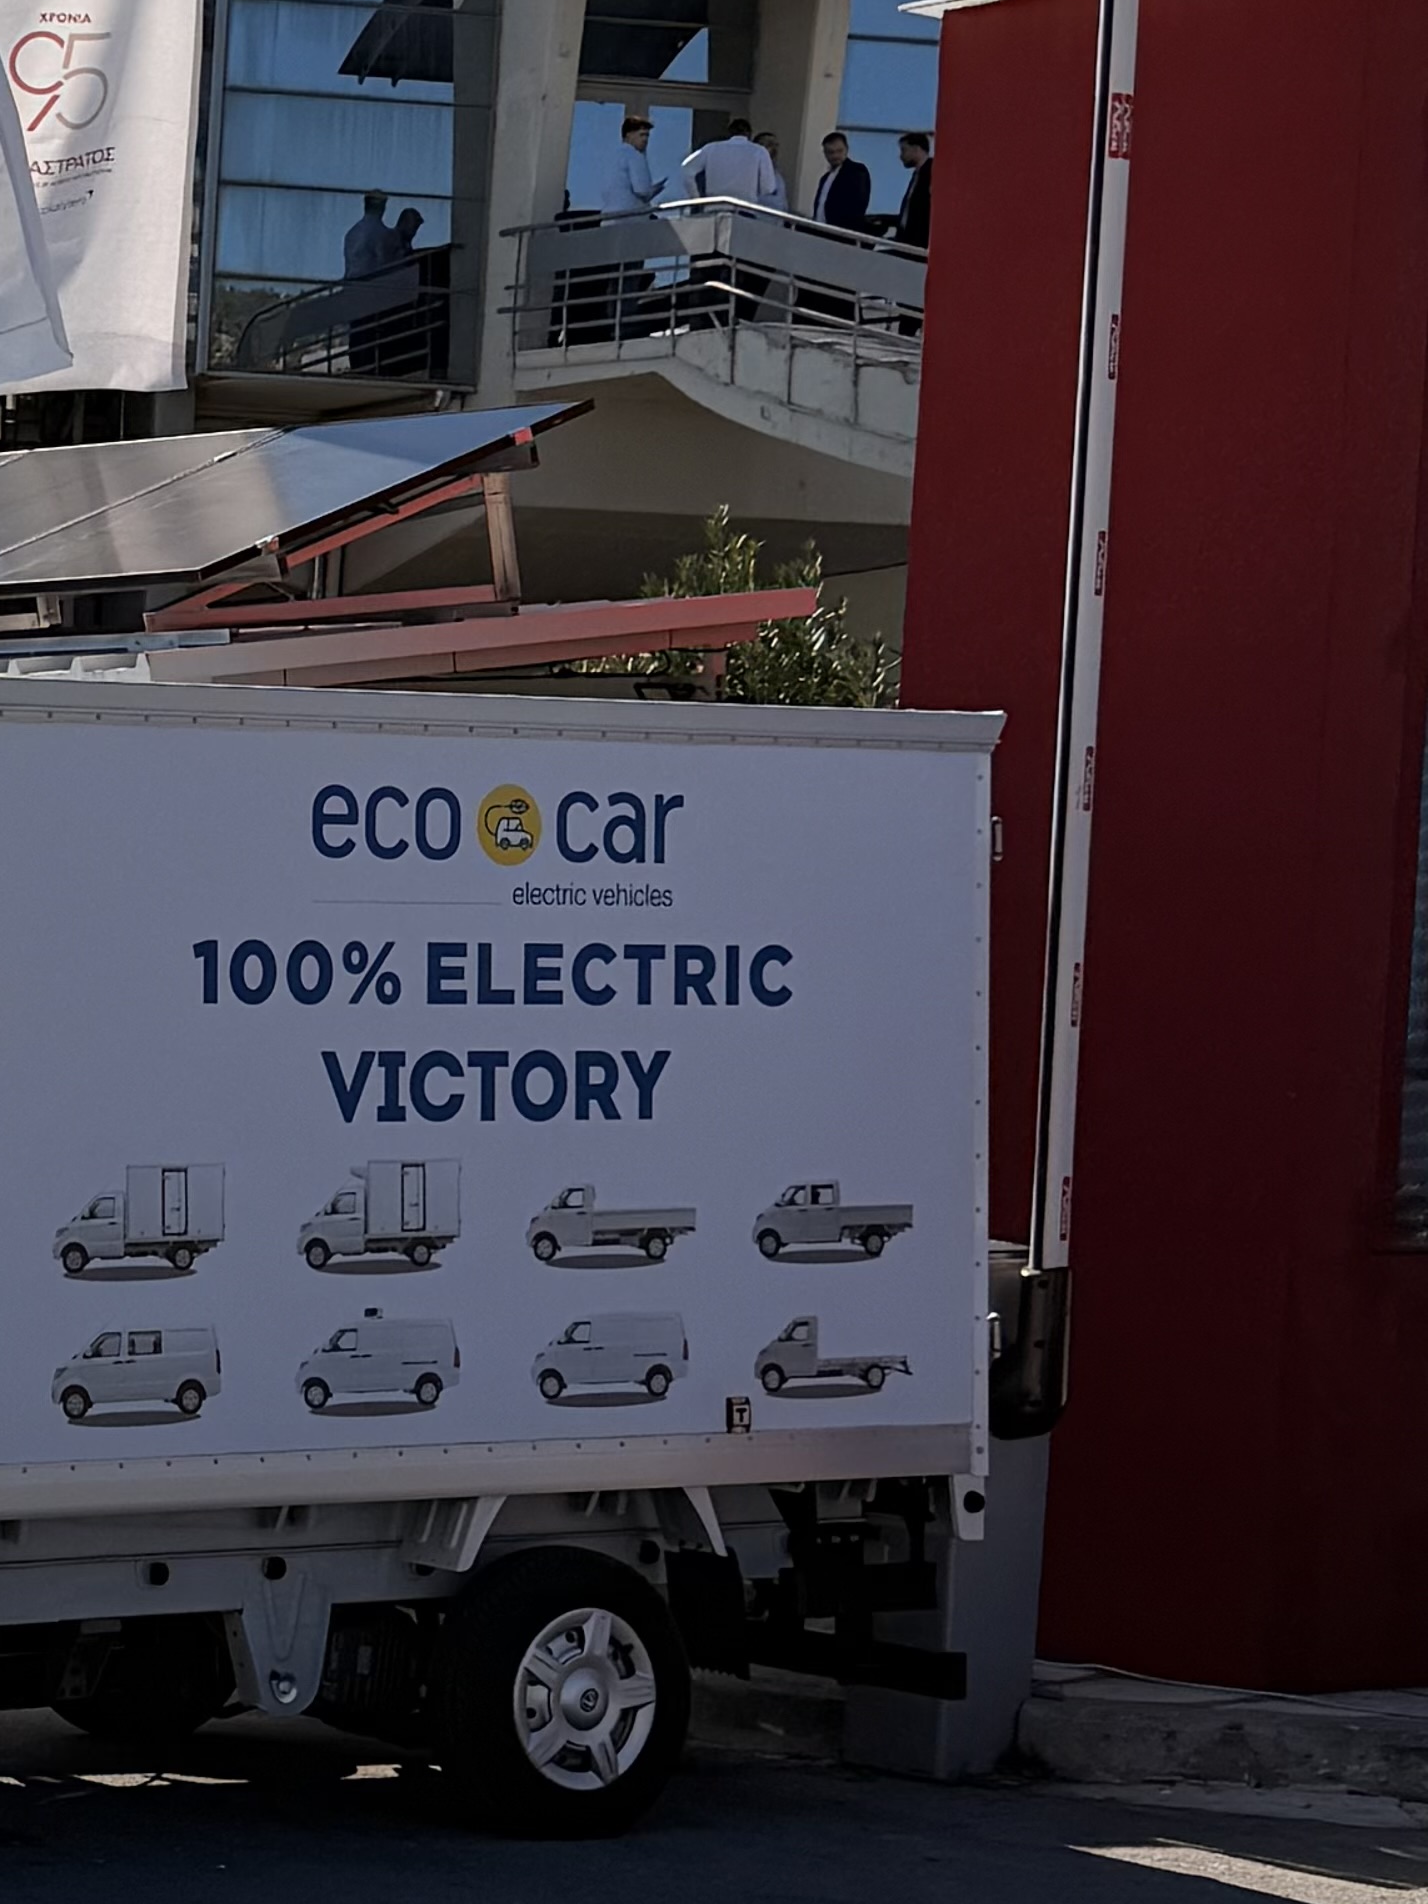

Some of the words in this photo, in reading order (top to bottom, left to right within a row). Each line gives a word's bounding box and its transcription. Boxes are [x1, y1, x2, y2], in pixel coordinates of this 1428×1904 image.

[9, 31, 111, 131] 95
[311, 783, 462, 861] eco
[555, 790, 685, 864] car
[512, 882, 587, 907] electric
[592, 882, 674, 908] vehicles
[192, 939, 402, 1006] 100%
[425, 942, 794, 1007] ELECTRIC
[320, 1049, 672, 1123] VICTORY
